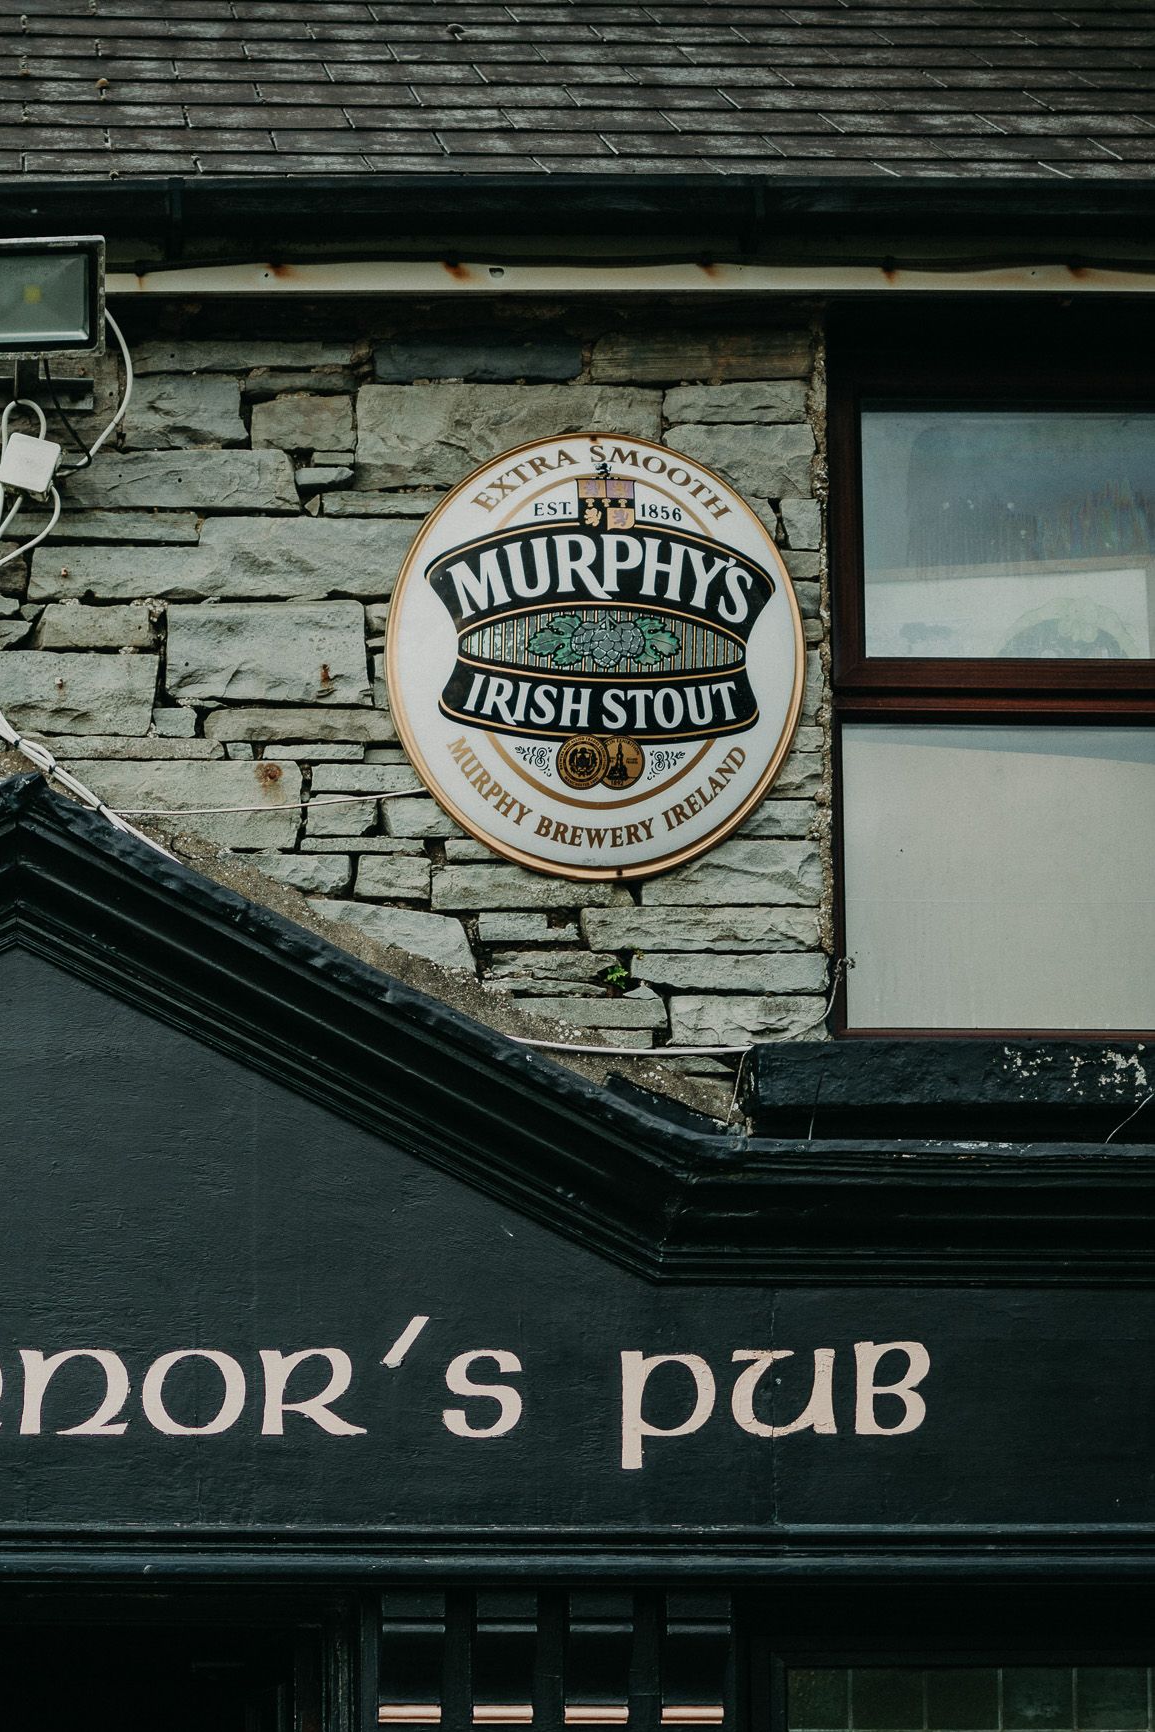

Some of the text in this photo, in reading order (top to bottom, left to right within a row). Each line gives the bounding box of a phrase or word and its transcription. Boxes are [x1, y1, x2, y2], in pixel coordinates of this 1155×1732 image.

[471, 445, 733, 521] EXTRA SMOOTH
[534, 502, 572, 517] EST.
[640, 503, 682, 522] 1856
[446, 534, 753, 623] MURPHY'S
[463, 673, 736, 729] IRISH STOUT
[446, 735, 746, 849] MURPHY BREWERY IRELAND
